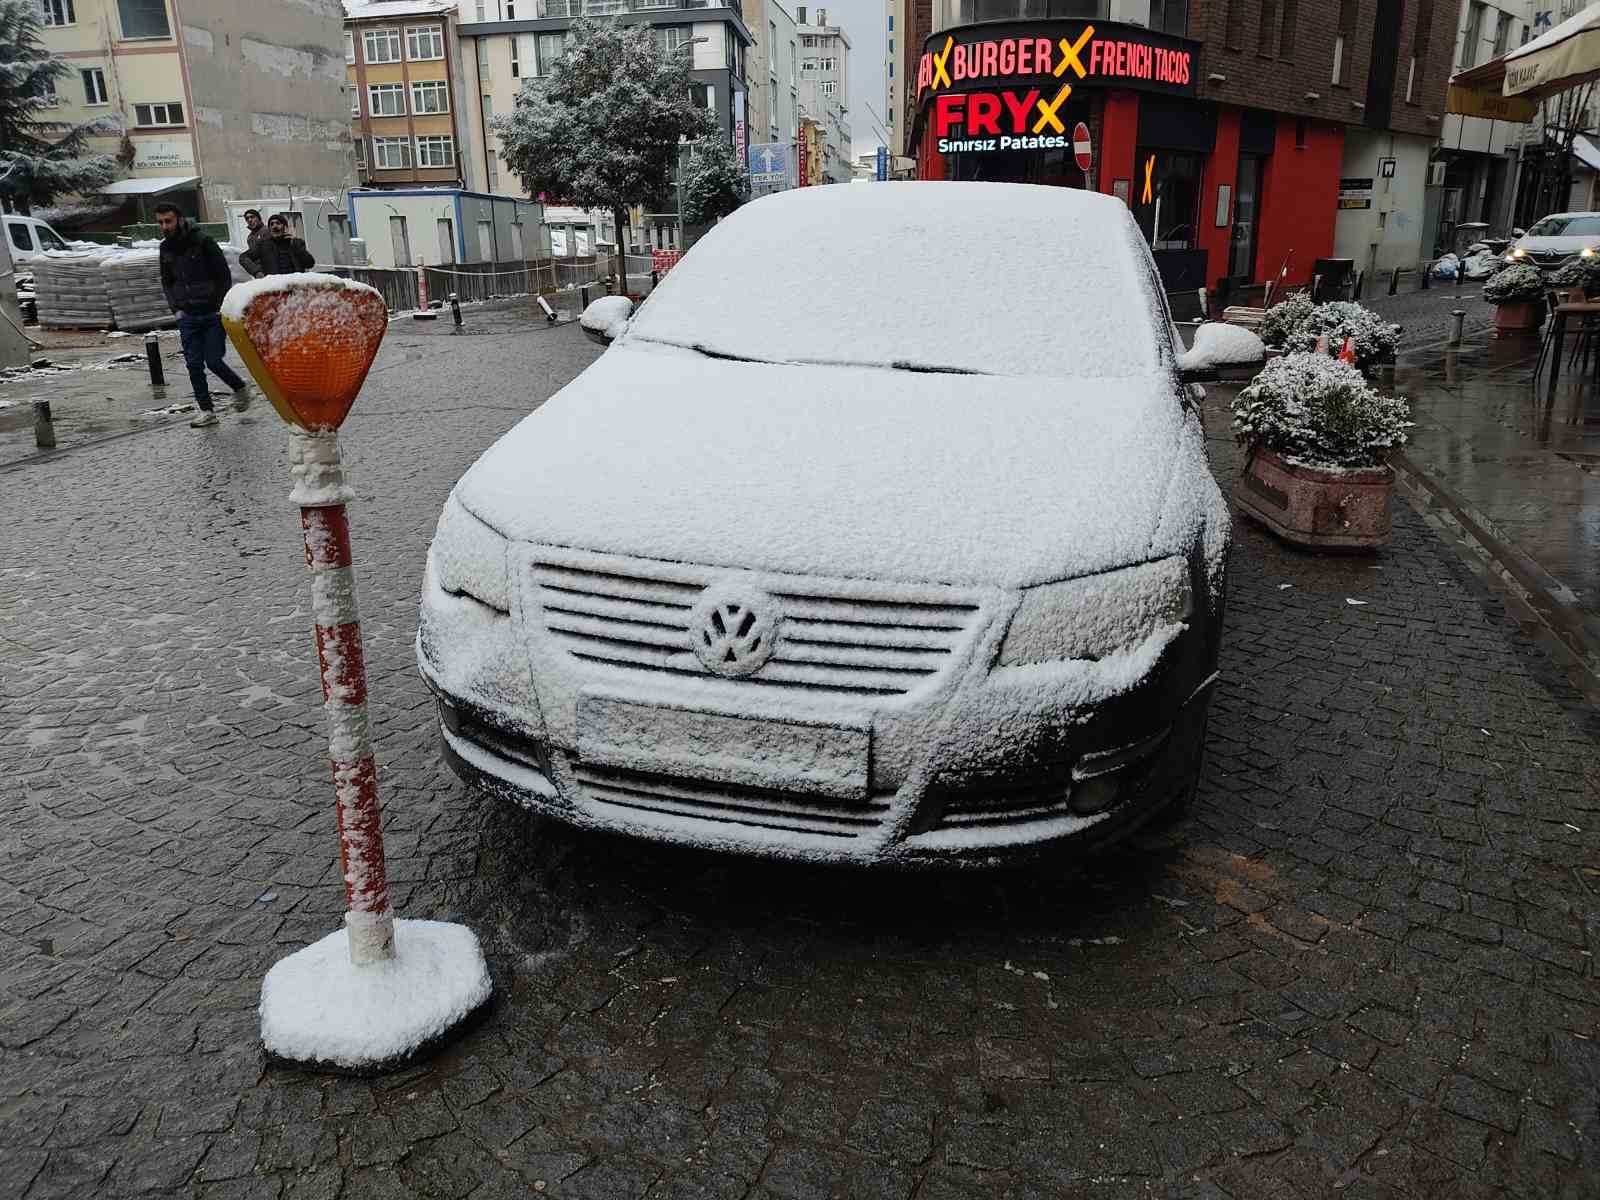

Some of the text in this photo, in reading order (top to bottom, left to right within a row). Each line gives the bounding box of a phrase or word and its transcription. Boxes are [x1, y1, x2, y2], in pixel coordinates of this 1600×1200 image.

[953, 38, 1053, 80] BURGER
[1089, 40, 1152, 79] FRENCH
[1154, 47, 1190, 85] TACOS
[938, 134, 1069, 153] Sınırsız Patates.
